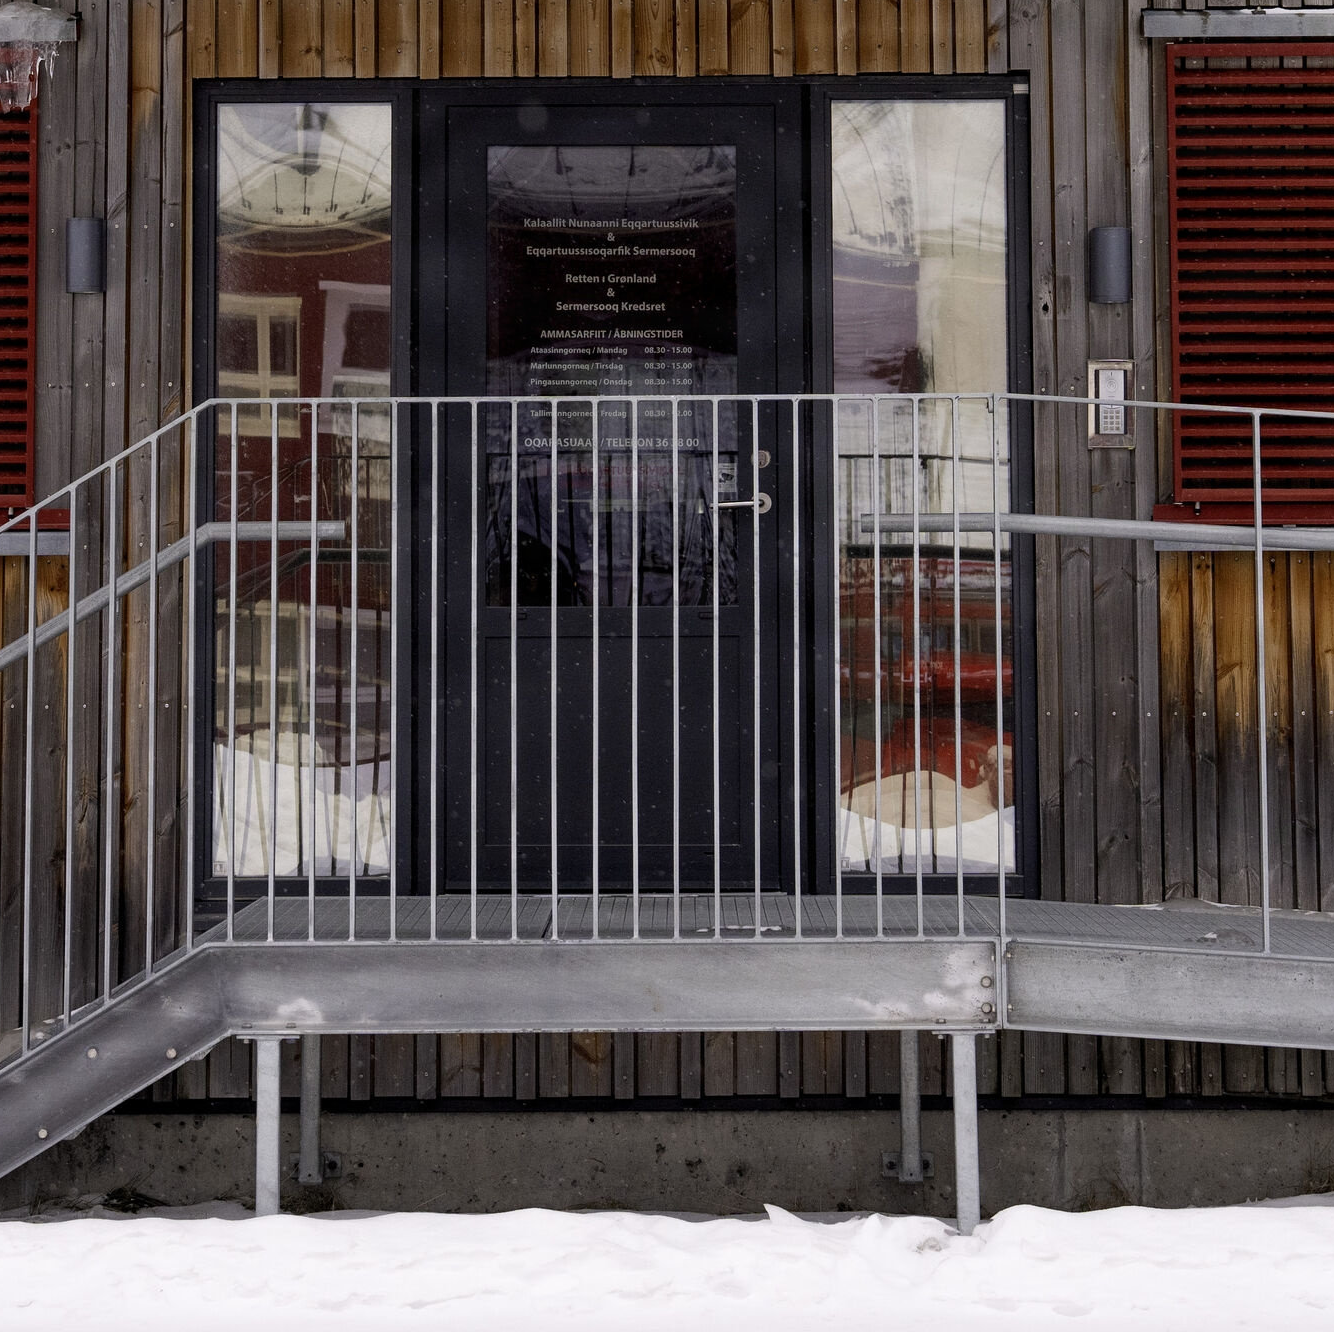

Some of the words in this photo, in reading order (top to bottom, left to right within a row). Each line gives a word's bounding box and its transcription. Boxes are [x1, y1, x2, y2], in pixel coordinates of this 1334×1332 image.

[523, 218, 567, 228] Kalaallit
[568, 218, 619, 228] Nunaanni
[621, 218, 699, 230] Eqqartuussivik
[607, 232, 615, 242] &
[633, 246, 696, 258] Sermersooq
[565, 274, 600, 283] Retten
[607, 274, 657, 283] Grønland
[607, 287, 615, 297] &
[556, 302, 619, 313] Sermersooq
[621, 302, 666, 311] Kredsret
[540, 330, 607, 339] AMMASARFIIT
[613, 328, 684, 339] ÅBNINGSTIDER
[530, 347, 591, 355] Ataasinngorneq
[597, 347, 628, 355] Mandag
[530, 363, 589, 371] Marlunngorneq
[595, 363, 623, 371] Tirsdag
[530, 379, 598, 387] Pingasunngorneq
[603, 379, 633, 387] Onsdag
[530, 410, 595, 418] Tallimnngorne
[601, 410, 627, 418] Fredag
[524, 438, 597, 448] OQAASUAA
[605, 438, 653, 447] TELEON
[655, 438, 668, 447] 36
[686, 438, 700, 447] 00
